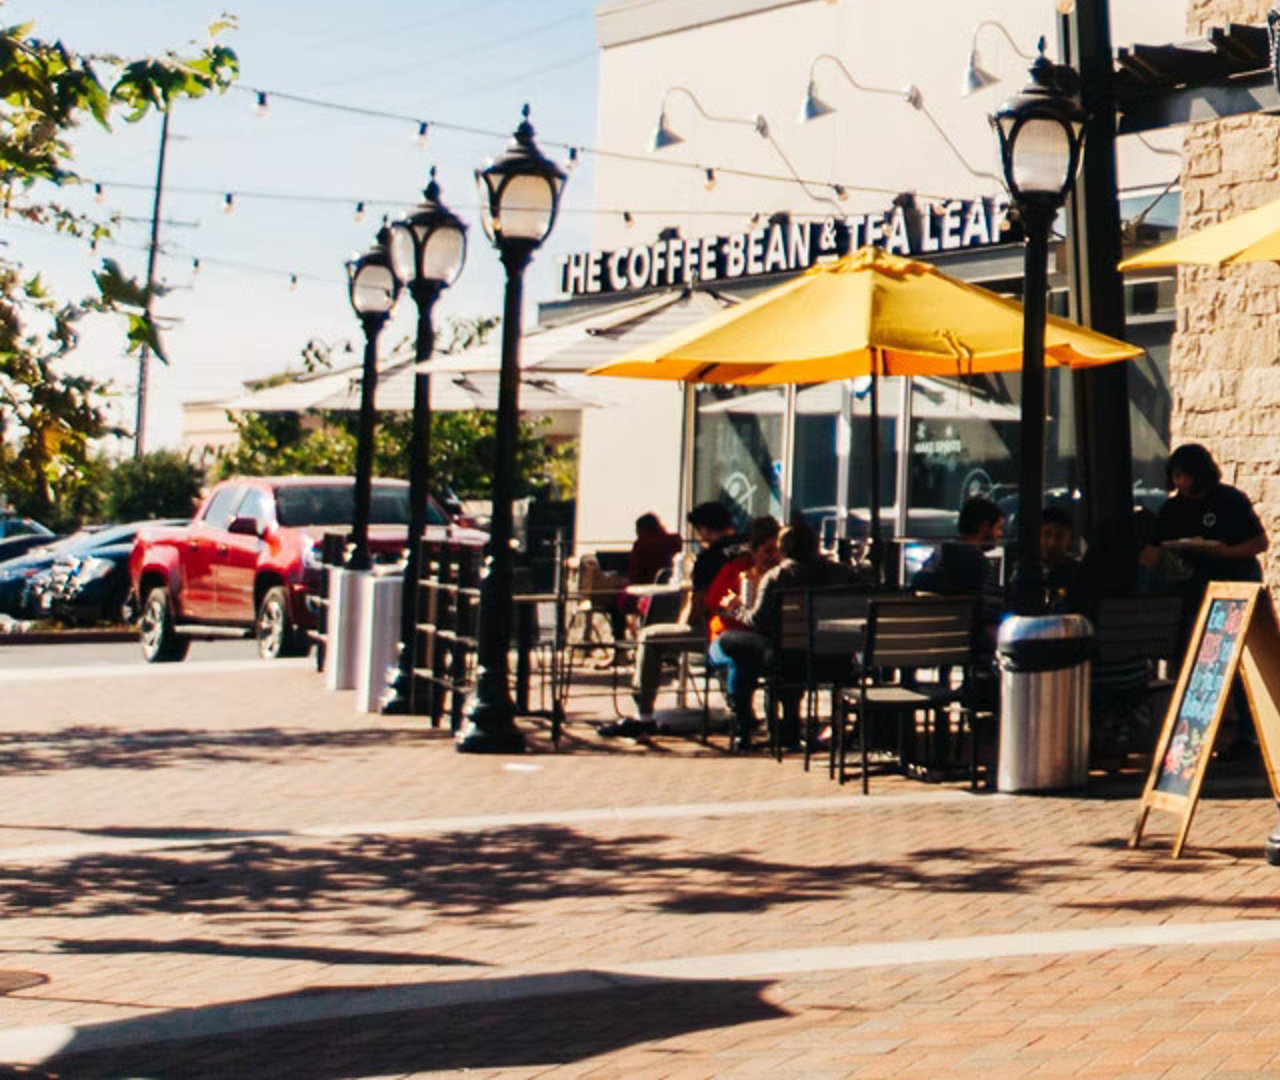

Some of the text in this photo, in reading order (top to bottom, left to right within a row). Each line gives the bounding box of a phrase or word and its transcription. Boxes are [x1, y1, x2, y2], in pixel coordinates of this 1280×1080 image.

[556, 194, 1013, 294] THE COFFEE BEAN & TEA LEAF
